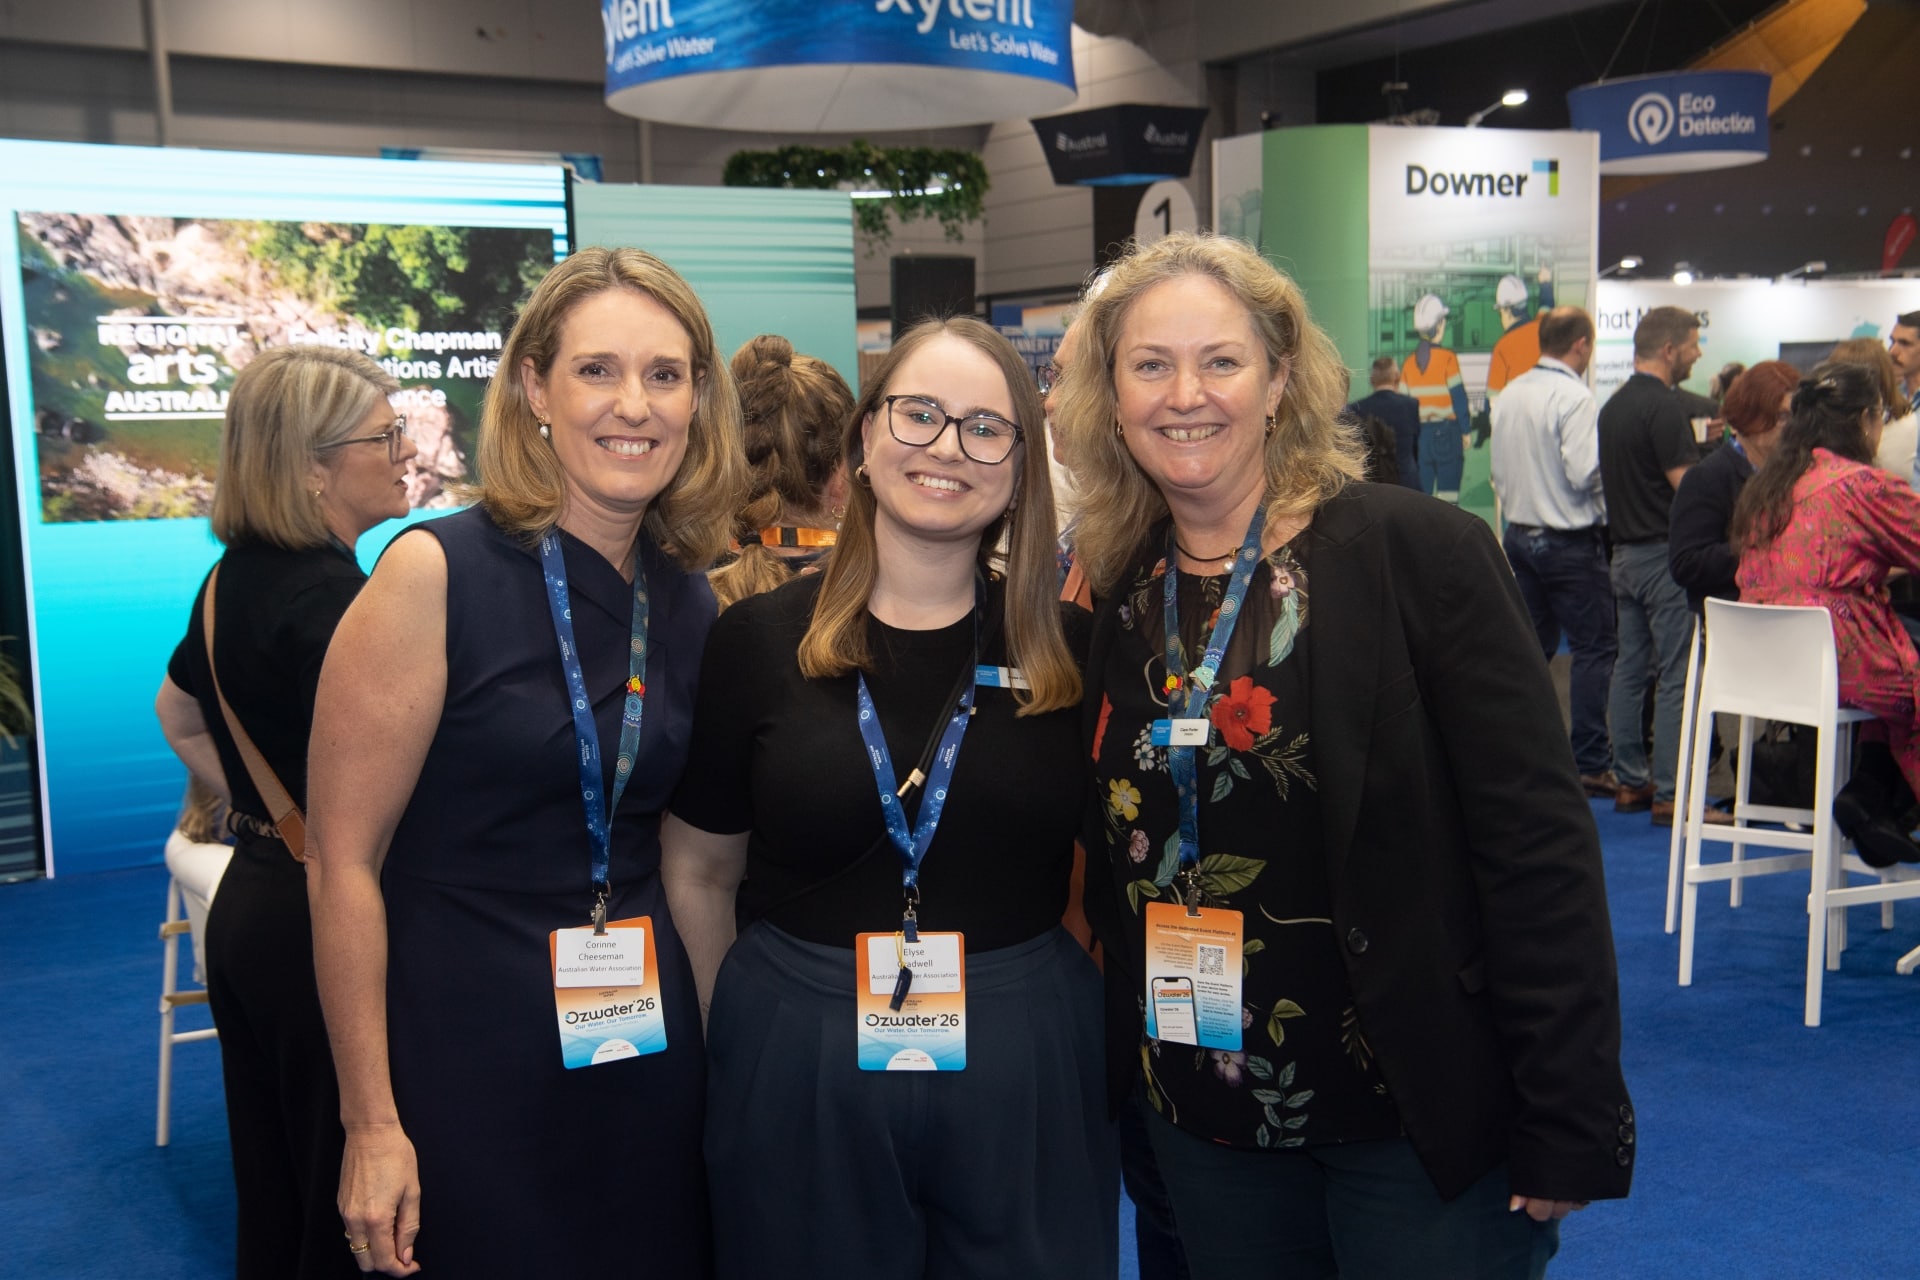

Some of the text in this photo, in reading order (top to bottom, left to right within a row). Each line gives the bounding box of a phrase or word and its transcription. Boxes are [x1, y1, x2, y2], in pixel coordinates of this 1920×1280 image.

[666, 35, 716, 58] Water
[950, 27, 988, 52] Let's
[990, 32, 1028, 58] Solve
[1679, 92, 1715, 114] Eco
[1679, 113, 1755, 137] Detection
[1405, 164, 1528, 196] Downer
[1154, 196, 1171, 236] 1
[1598, 307, 1631, 329] hat
[97, 324, 243, 347] REGIONAL
[288, 326, 502, 353] Felicity Chapman
[127, 348, 219, 385] arts
[447, 356, 500, 379] Artis
[104, 389, 231, 412] AUSTRALI
[585, 940, 616, 949] Corinne
[903, 948, 925, 957] Elyse
[578, 953, 624, 961] Cheeseman
[897, 960, 933, 968] adwell
[575, 1023, 586, 1031] Our
[587, 1021, 605, 1029] Water.
